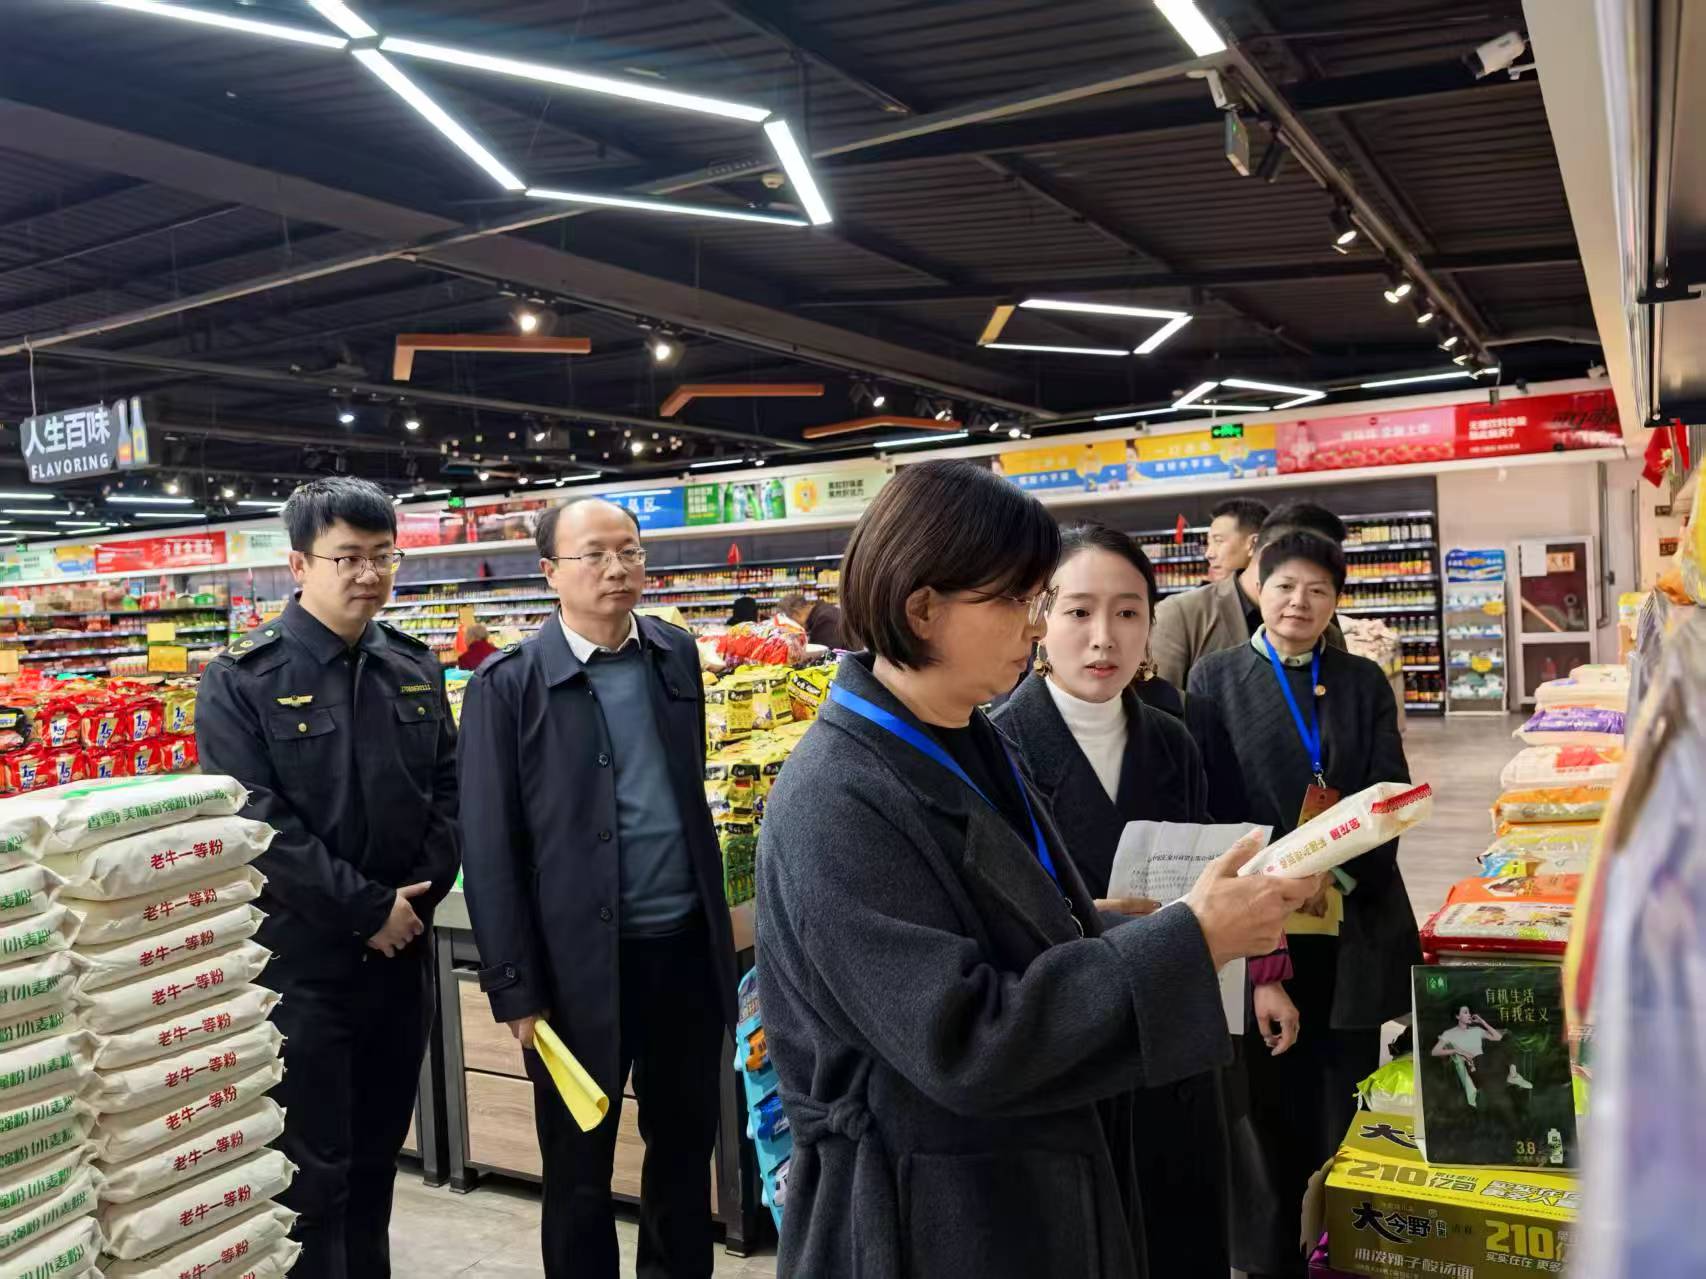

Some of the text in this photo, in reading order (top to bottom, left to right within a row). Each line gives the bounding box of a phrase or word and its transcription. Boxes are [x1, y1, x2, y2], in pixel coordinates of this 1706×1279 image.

[24, 408, 111, 457] 人生百味
[31, 453, 109, 479] FLAVORING
[151, 839, 223, 870] 老牛一等粉
[144, 888, 217, 921] 老牛一等粉
[140, 930, 215, 967] 老牛一等粉
[152, 968, 223, 1006] 老牛一等粉
[1486, 988, 1534, 1003] 有机生活
[158, 1013, 231, 1046] 老牛一等粉
[1500, 1007, 1549, 1022] 有我定义
[165, 1051, 236, 1088] 老牛一等粉
[165, 1085, 237, 1130] 老牛一等粉
[174, 1130, 243, 1171] 老牛一等粉
[1348, 1160, 1428, 1187] 210
[180, 1185, 251, 1226] 老牛一等粉
[1351, 1200, 1430, 1244] 大今野
[1485, 1219, 1554, 1260] 210
[179, 1239, 249, 1279] 老牛一等粉
